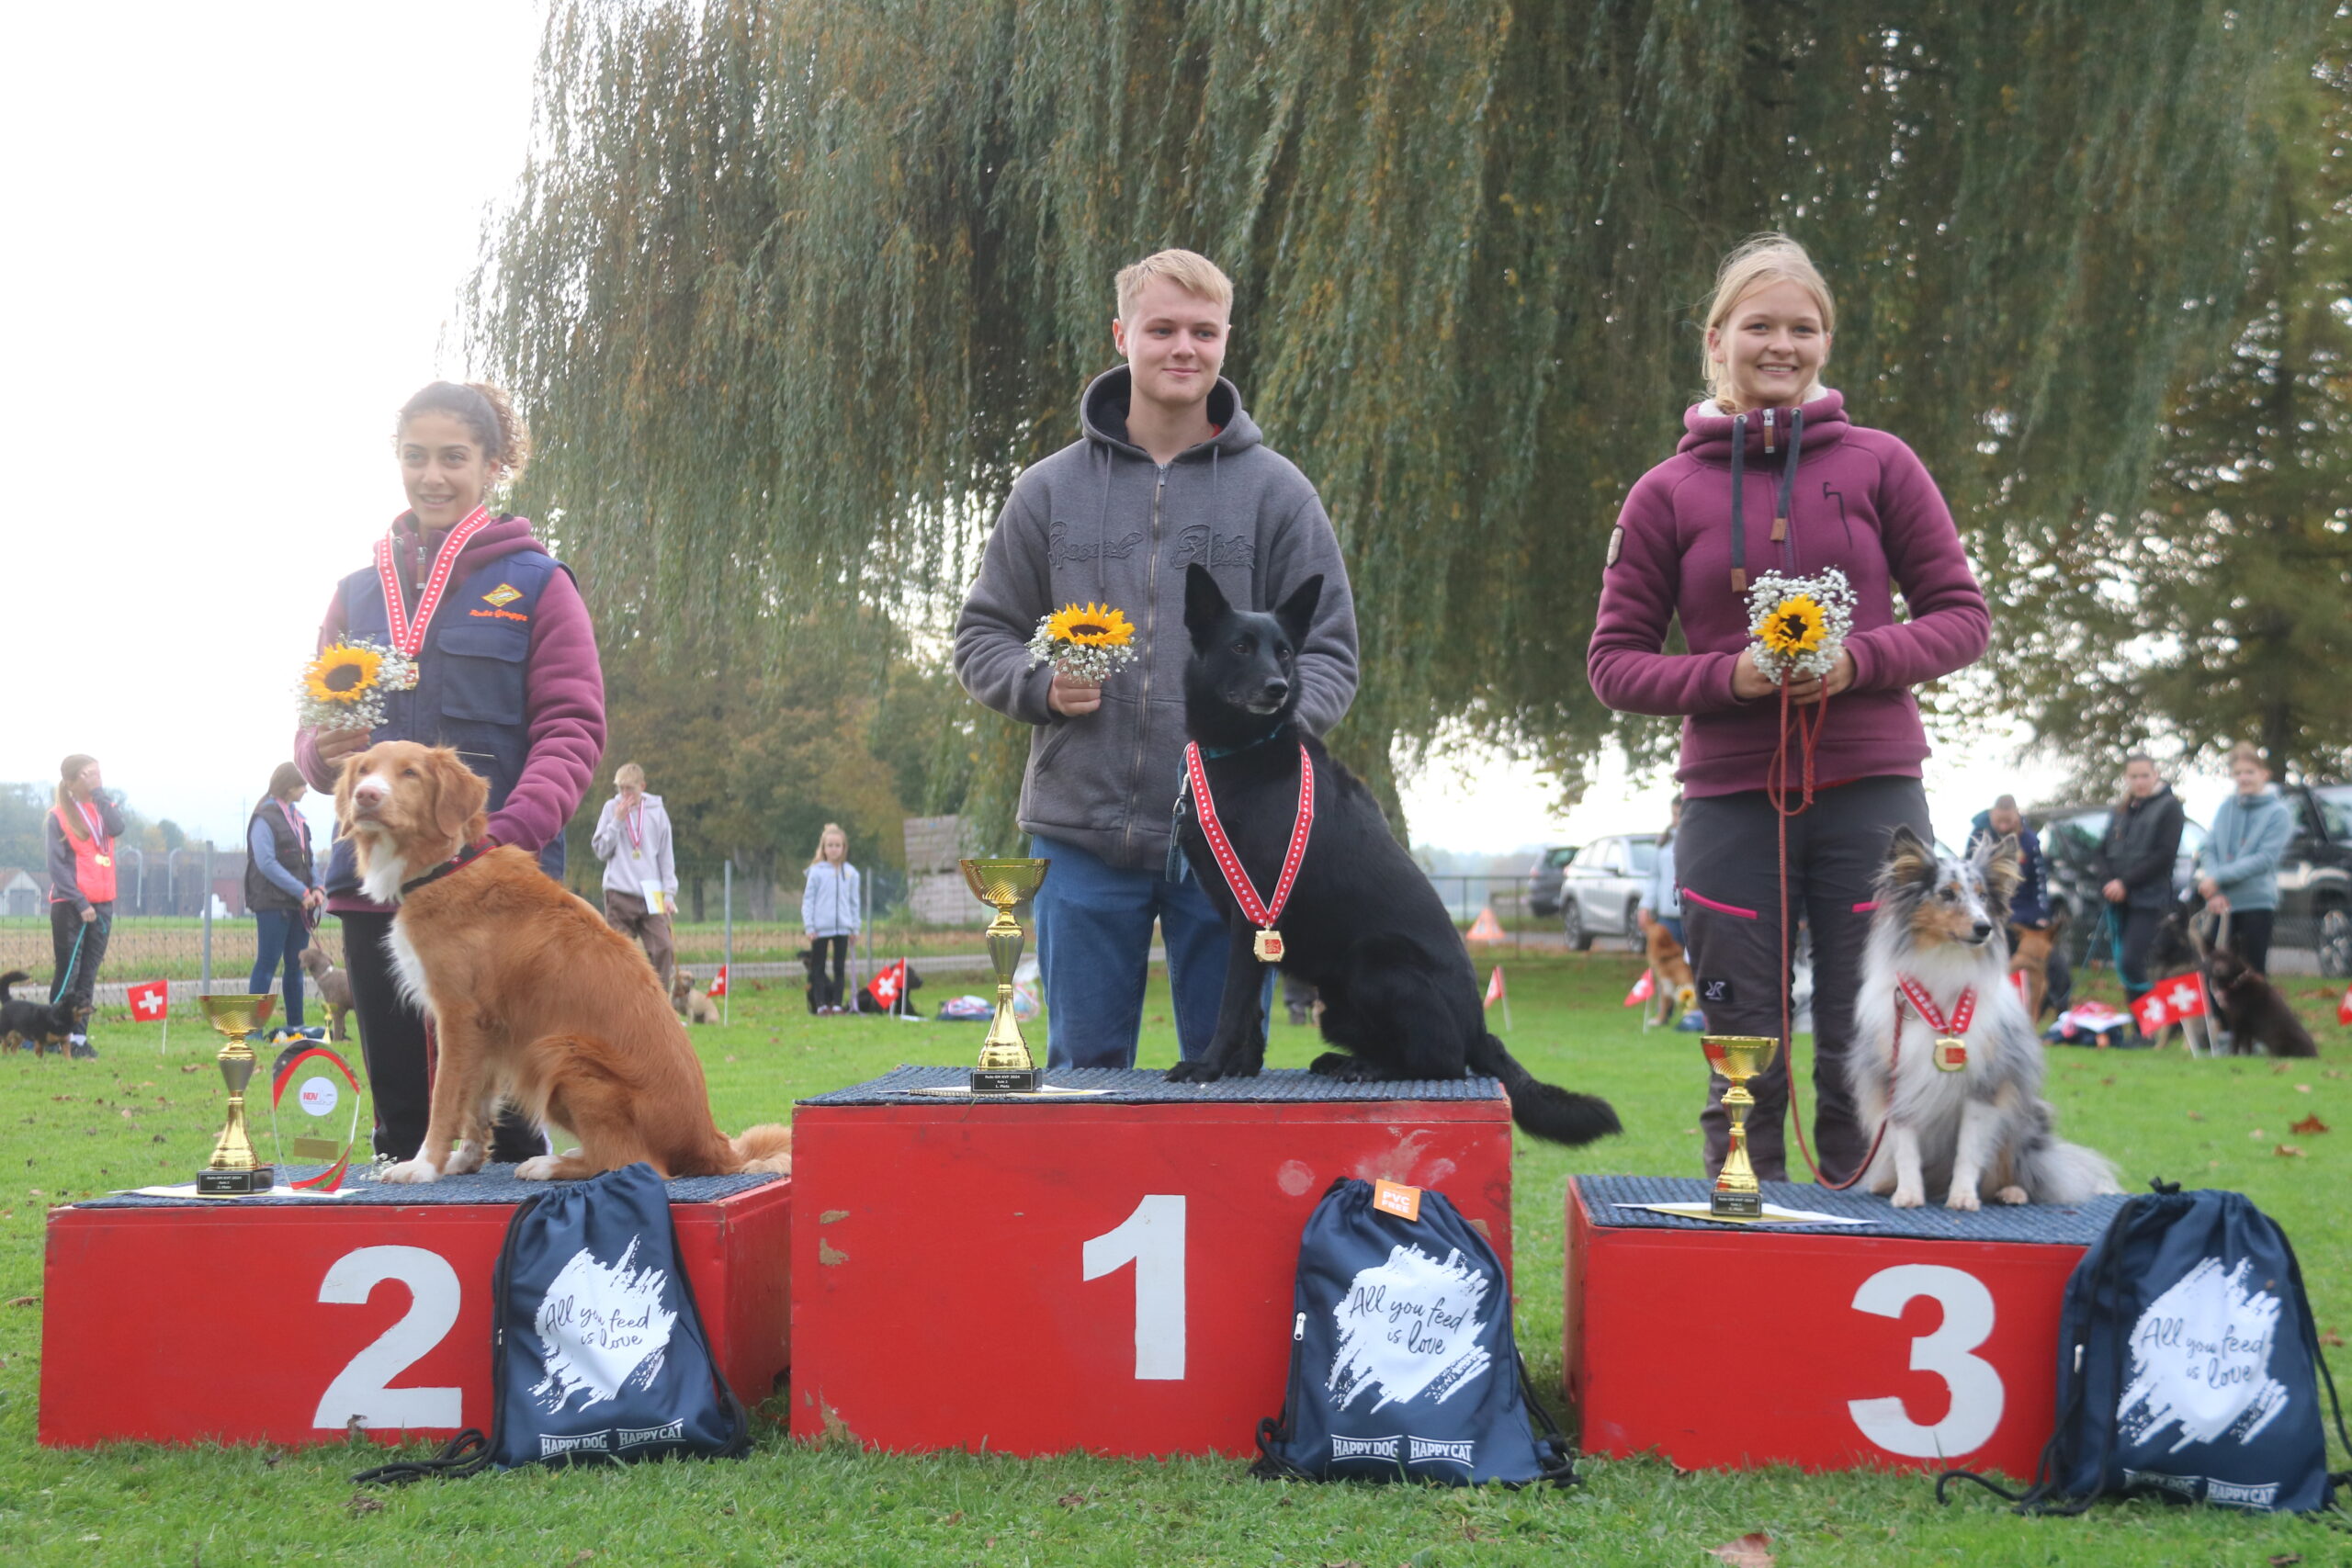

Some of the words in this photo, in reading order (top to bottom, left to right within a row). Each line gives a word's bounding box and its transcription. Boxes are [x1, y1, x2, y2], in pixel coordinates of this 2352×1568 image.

[1382, 1200, 1409, 1213] FREE
[1383, 1190, 1410, 1205] PVC
[1082, 1194, 1186, 1381] 1
[545, 1294, 574, 1335] All
[580, 1307, 605, 1328] you
[609, 1304, 651, 1333] feed
[1349, 1284, 1385, 1318] All
[1389, 1301, 1426, 1324] you
[1427, 1297, 1469, 1335] feed
[312, 1245, 462, 1430] 2
[581, 1332, 594, 1345] is
[600, 1328, 643, 1349] love
[1387, 1328, 1402, 1344] is
[1408, 1320, 1446, 1355] love
[2141, 1317, 2183, 1349] All
[2187, 1337, 2217, 1359] you
[2222, 1324, 2267, 1359] feed
[1848, 1263, 2006, 1459] 3
[2186, 1363, 2199, 1380] is
[2208, 1357, 2252, 1389] love
[541, 1438, 582, 1457] HAPPY
[582, 1434, 608, 1450] DOG
[617, 1429, 658, 1447] HAPPY
[659, 1423, 684, 1439] CAT
[1332, 1438, 1371, 1458] HAPPY
[1373, 1439, 1398, 1458] DOG
[1409, 1439, 1450, 1459] HAPPY
[1451, 1444, 1473, 1462] CAT
[2125, 1472, 2165, 1487] HPPY
[2167, 1479, 2197, 1494] DOG
[2207, 1482, 2250, 1501] HAPPY
[2250, 1487, 2278, 1505] CAT
